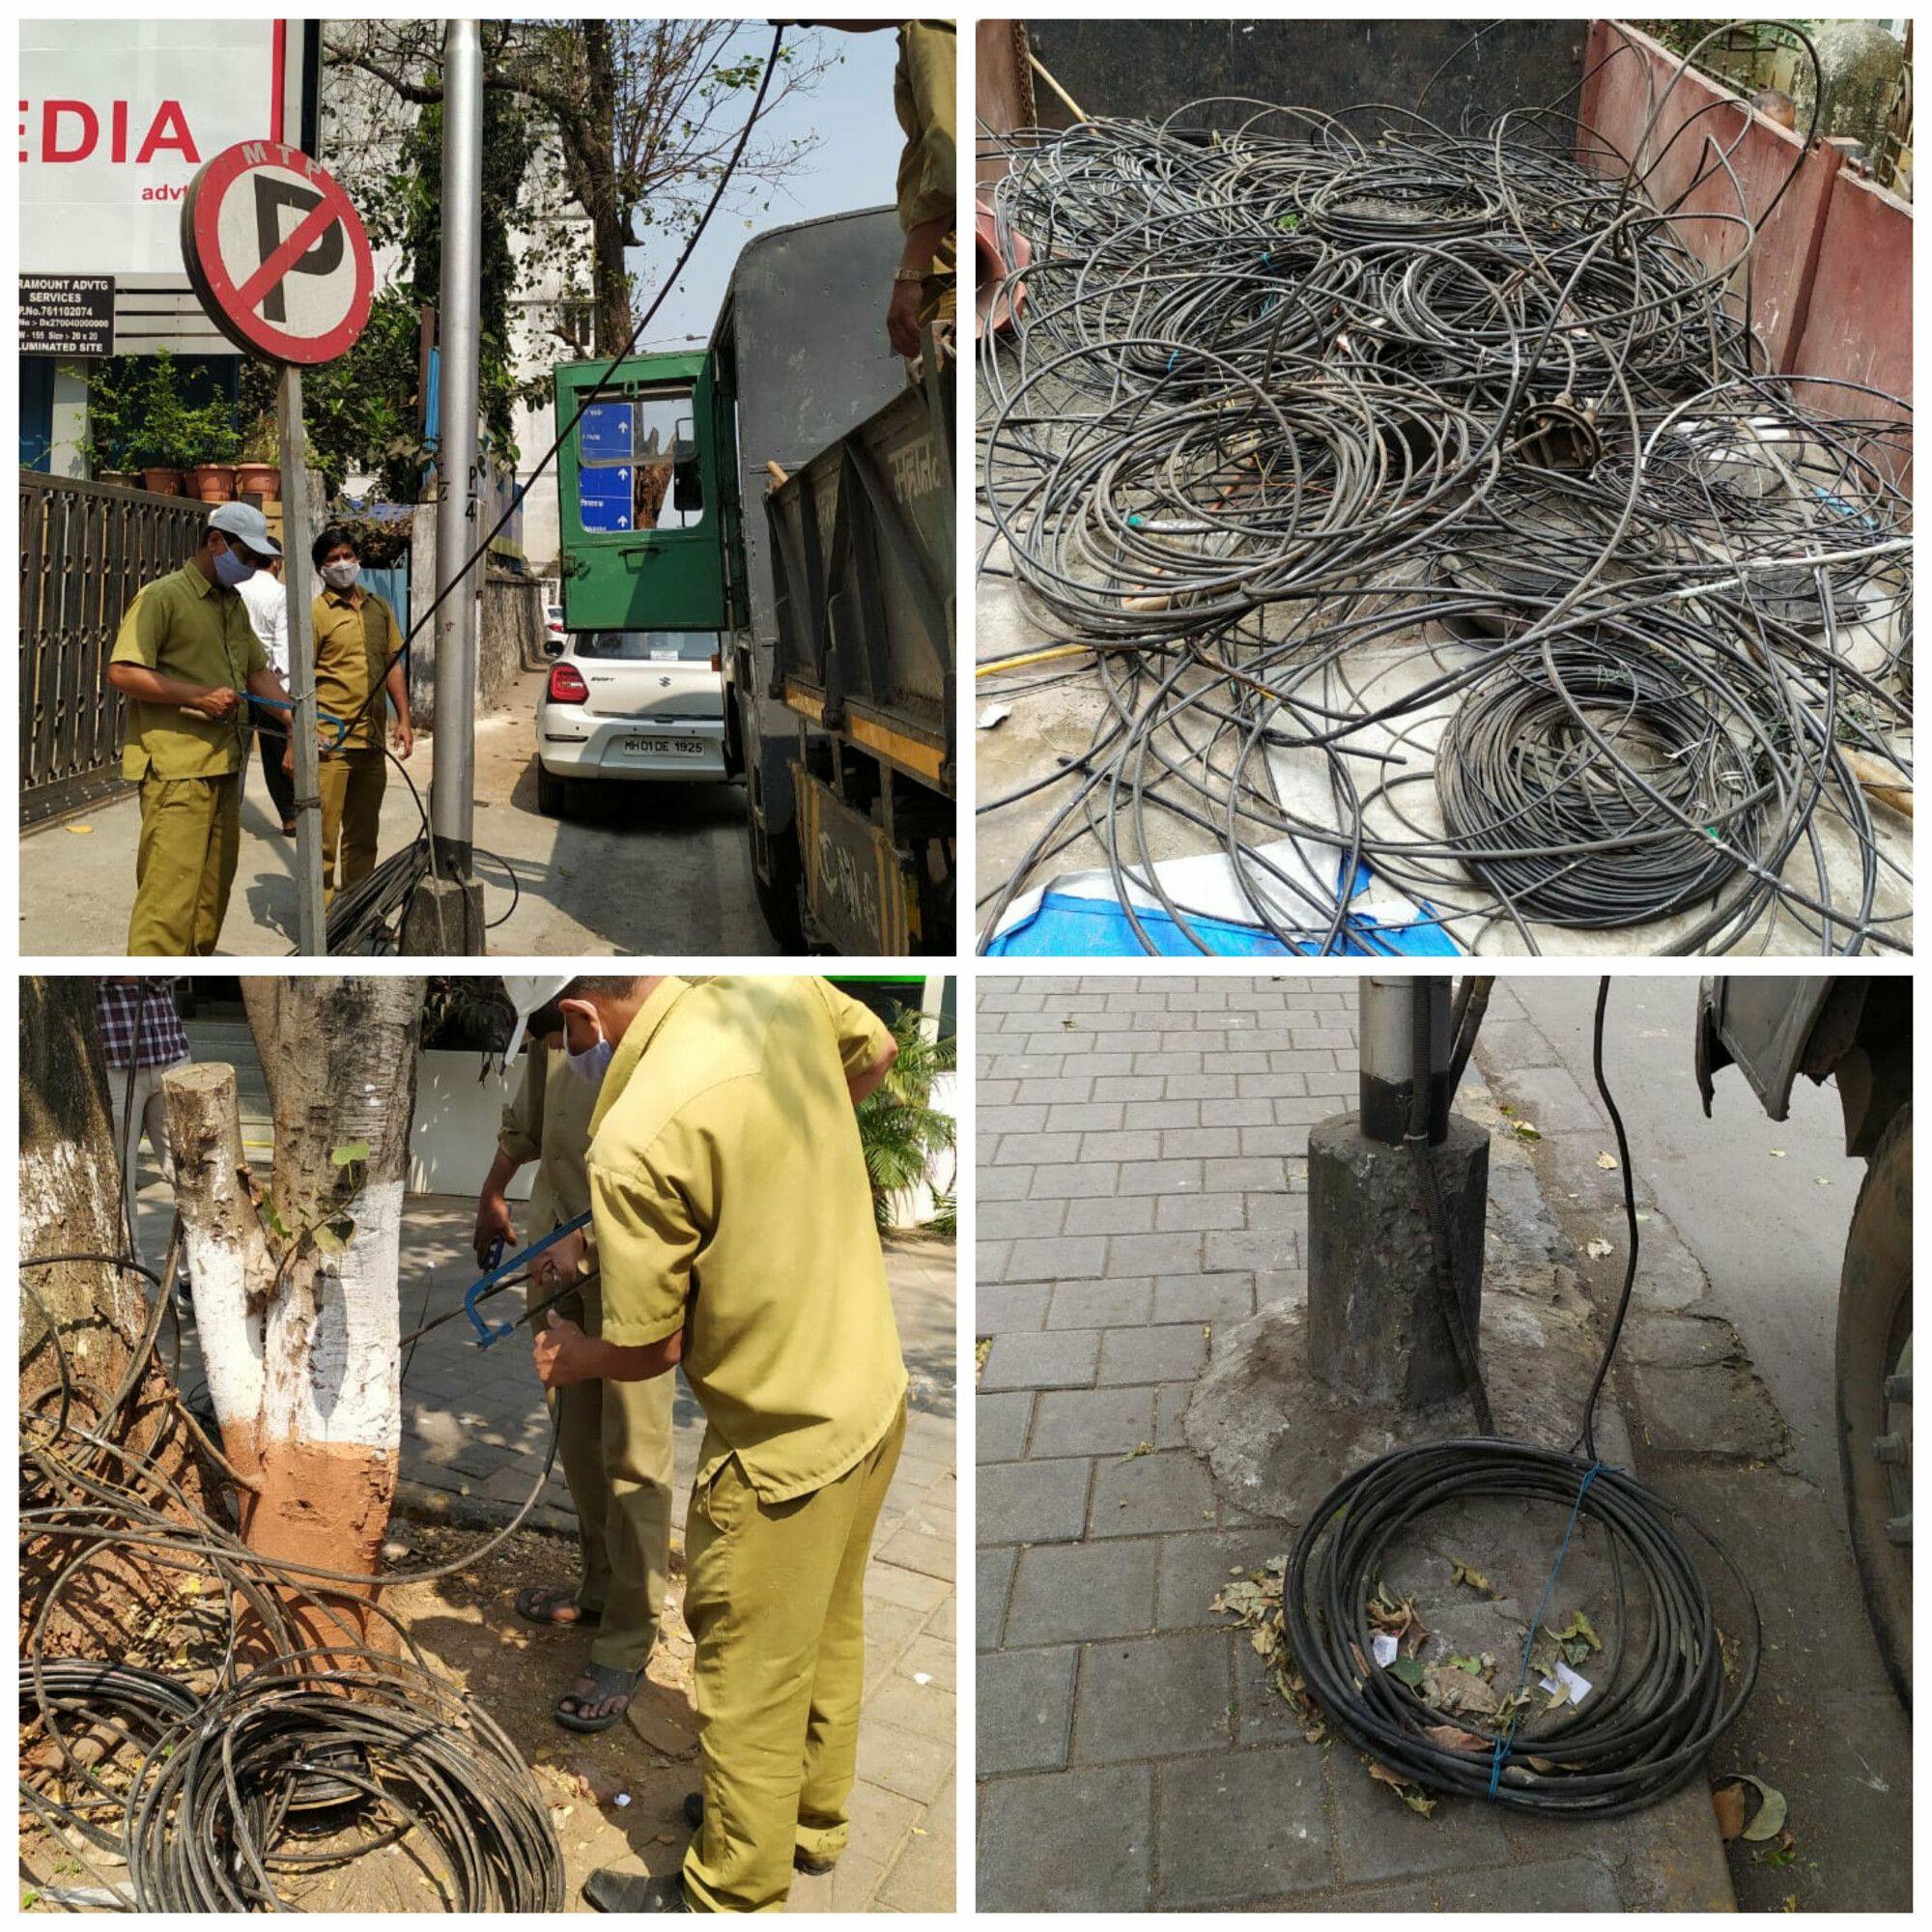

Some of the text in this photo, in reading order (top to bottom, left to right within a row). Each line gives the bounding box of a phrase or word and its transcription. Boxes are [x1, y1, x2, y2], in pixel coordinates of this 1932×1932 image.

[19, 100, 202, 163] DIA
[72, 280, 108, 291] ADVTG
[29, 293, 82, 302] SERVICES
[79, 343, 103, 353] SITE
[675, 742, 703, 753] 1925
